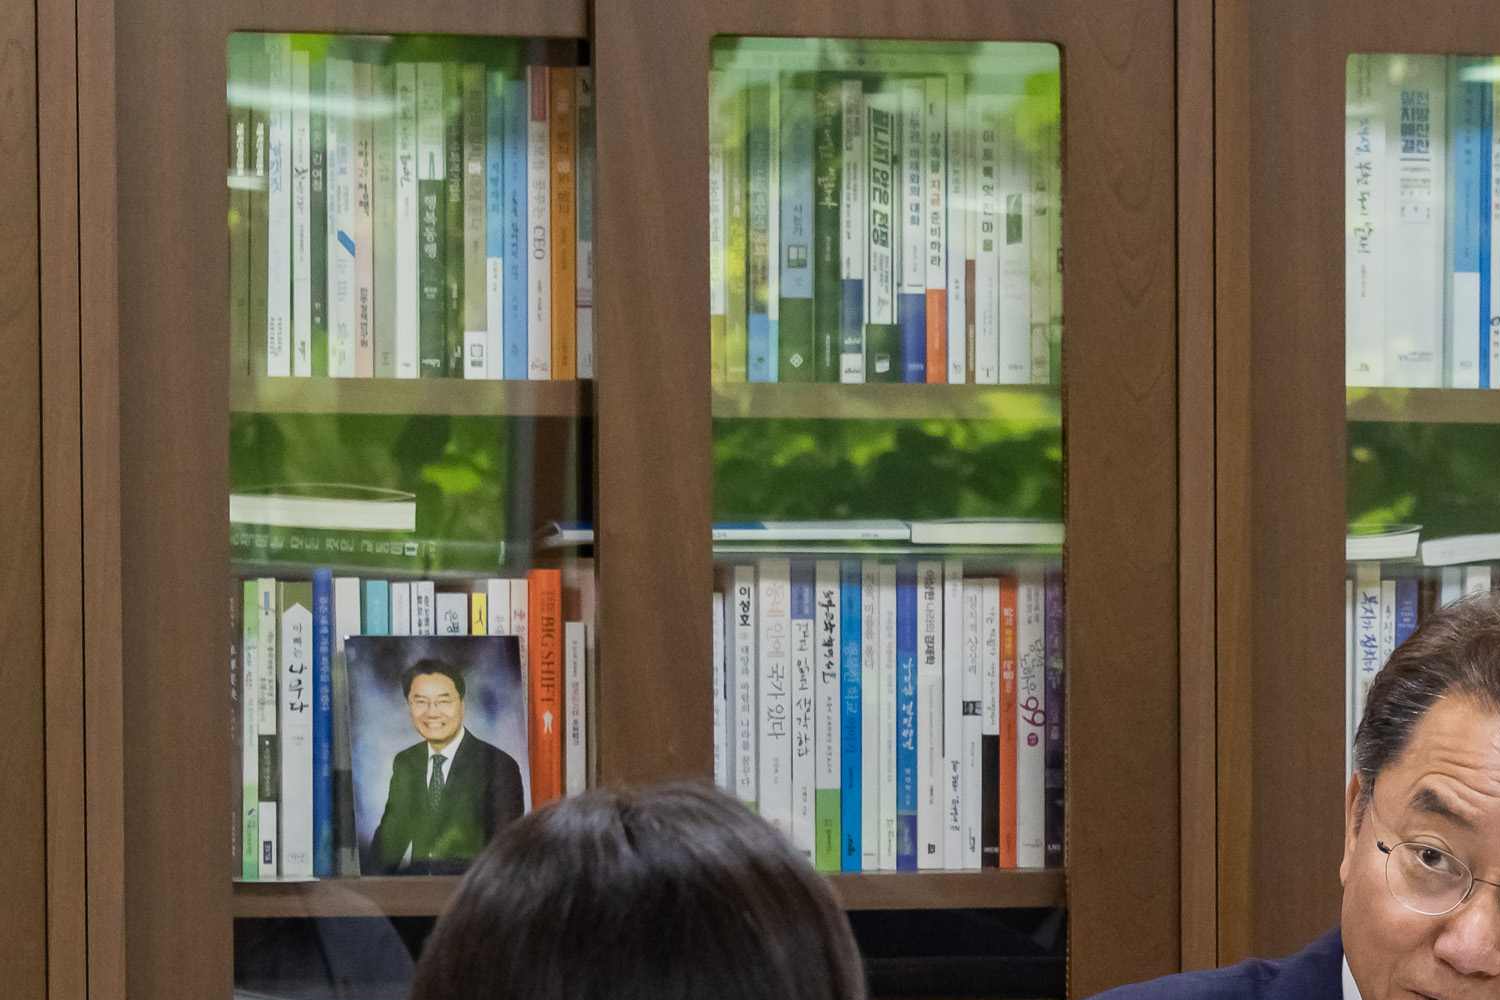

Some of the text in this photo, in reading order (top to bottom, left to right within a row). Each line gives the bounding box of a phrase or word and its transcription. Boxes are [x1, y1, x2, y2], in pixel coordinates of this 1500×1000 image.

[533, 225, 547, 261] CEO
[540, 616, 556, 647] BIG
[766, 621, 787, 658] 안에
[923, 633, 937, 665] 경제학
[540, 650, 556, 704] SHIFT
[765, 661, 787, 699] 국가
[1019, 652, 1046, 727] 노하우 99
[765, 702, 787, 740] 있다
